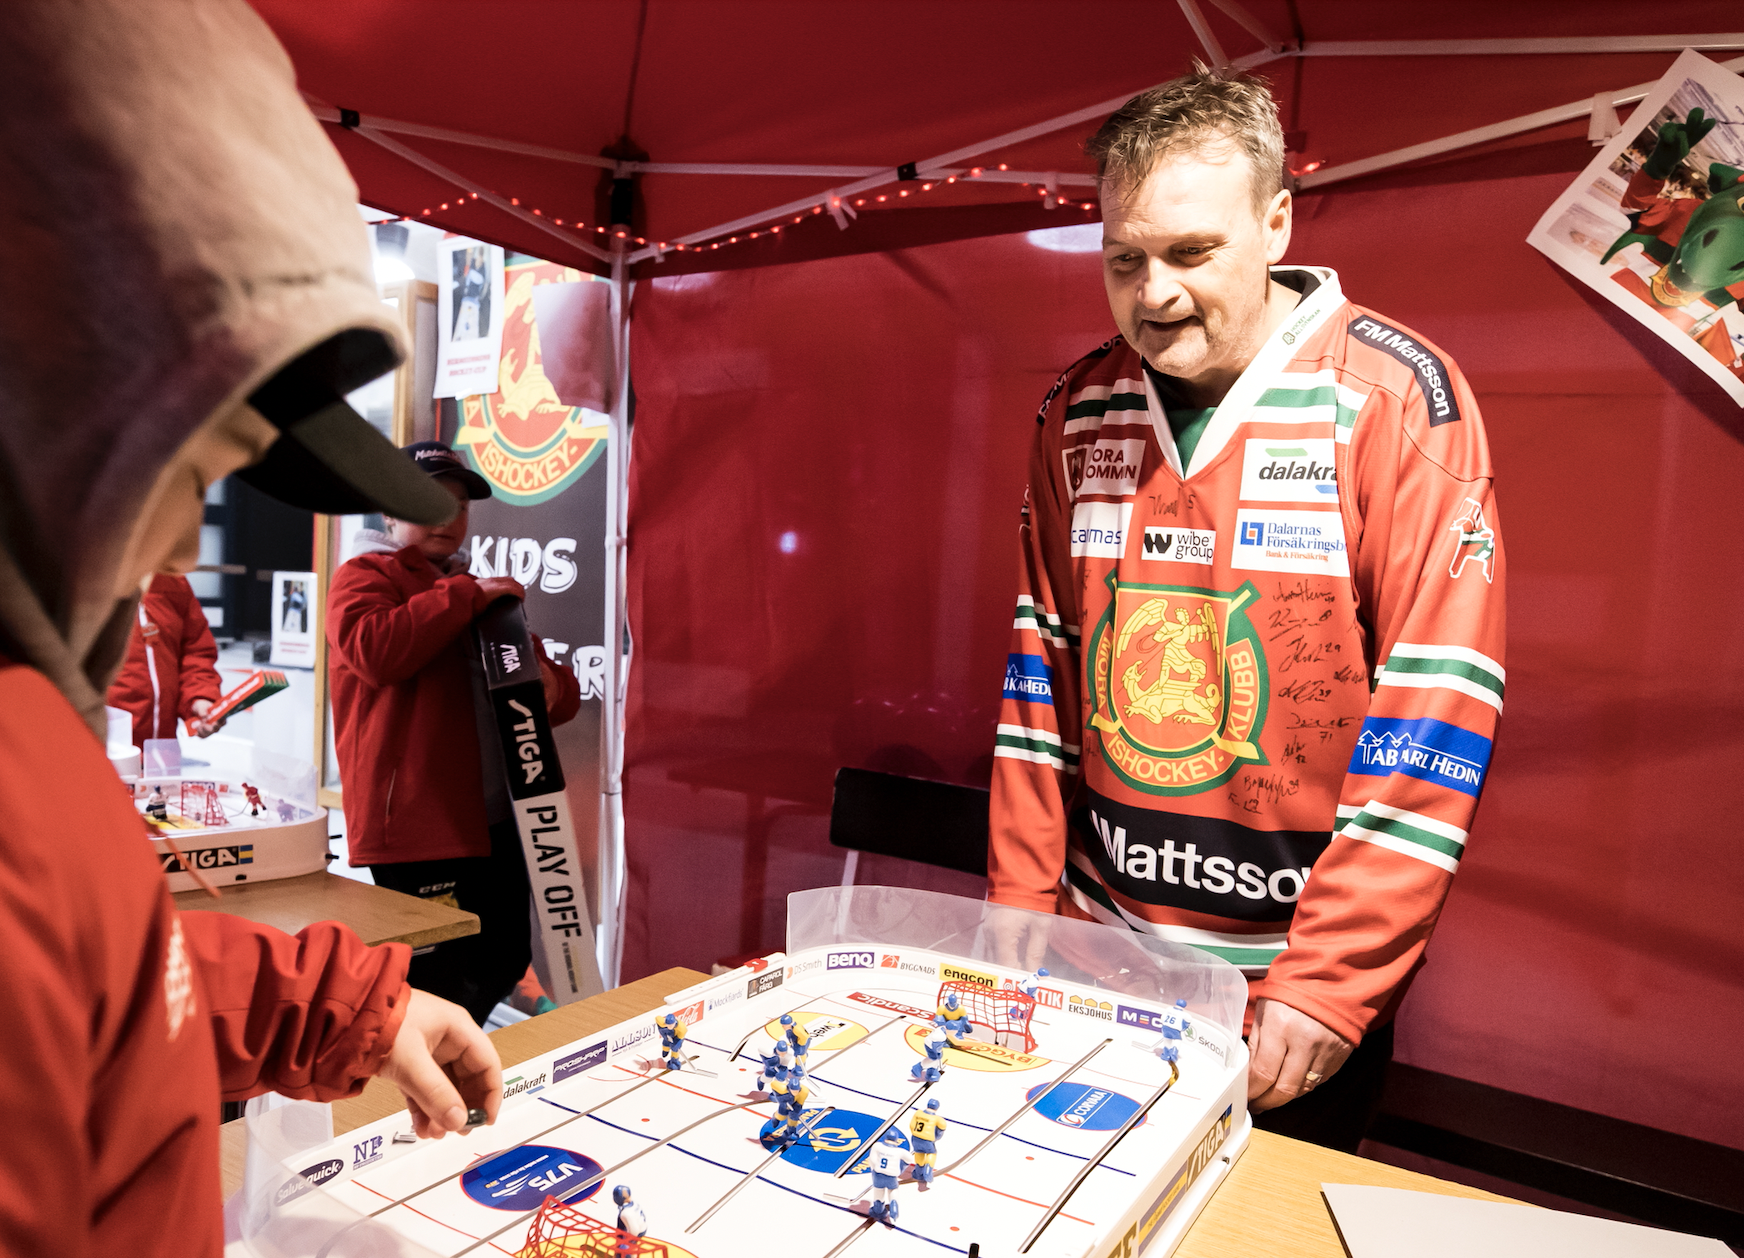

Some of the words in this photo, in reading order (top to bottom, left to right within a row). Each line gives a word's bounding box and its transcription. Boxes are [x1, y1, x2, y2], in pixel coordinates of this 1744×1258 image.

[1092, 449, 1124, 463] ORA
[1177, 531, 1210, 547] wibe
[1268, 522, 1322, 536] Dalarnas
[469, 535, 578, 593] KIDS
[1175, 545, 1214, 562] group
[1266, 550, 1282, 558] Bank
[1290, 552, 1328, 562] Försäkring
[500, 643, 521, 674] STIGA
[1097, 637, 1111, 710] MORA
[1228, 651, 1255, 740] KLUBB
[508, 699, 544, 785] STIGA
[1371, 748, 1399, 767] AB
[1399, 748, 1430, 769] ARL
[1430, 754, 1481, 787] HEDIN
[526, 805, 569, 876] PLAY
[1090, 799, 1312, 904] Mattsso
[419, 881, 456, 894] CCM
[543, 885, 582, 938] OFF
[803, 959, 823, 973] Smith
[900, 962, 936, 975] BYGGNADS
[944, 967, 994, 988] engcon
[503, 1072, 547, 1100] dalakraft
[528, 1162, 584, 1191] V75
[880, 1158, 888, 1169] 9
